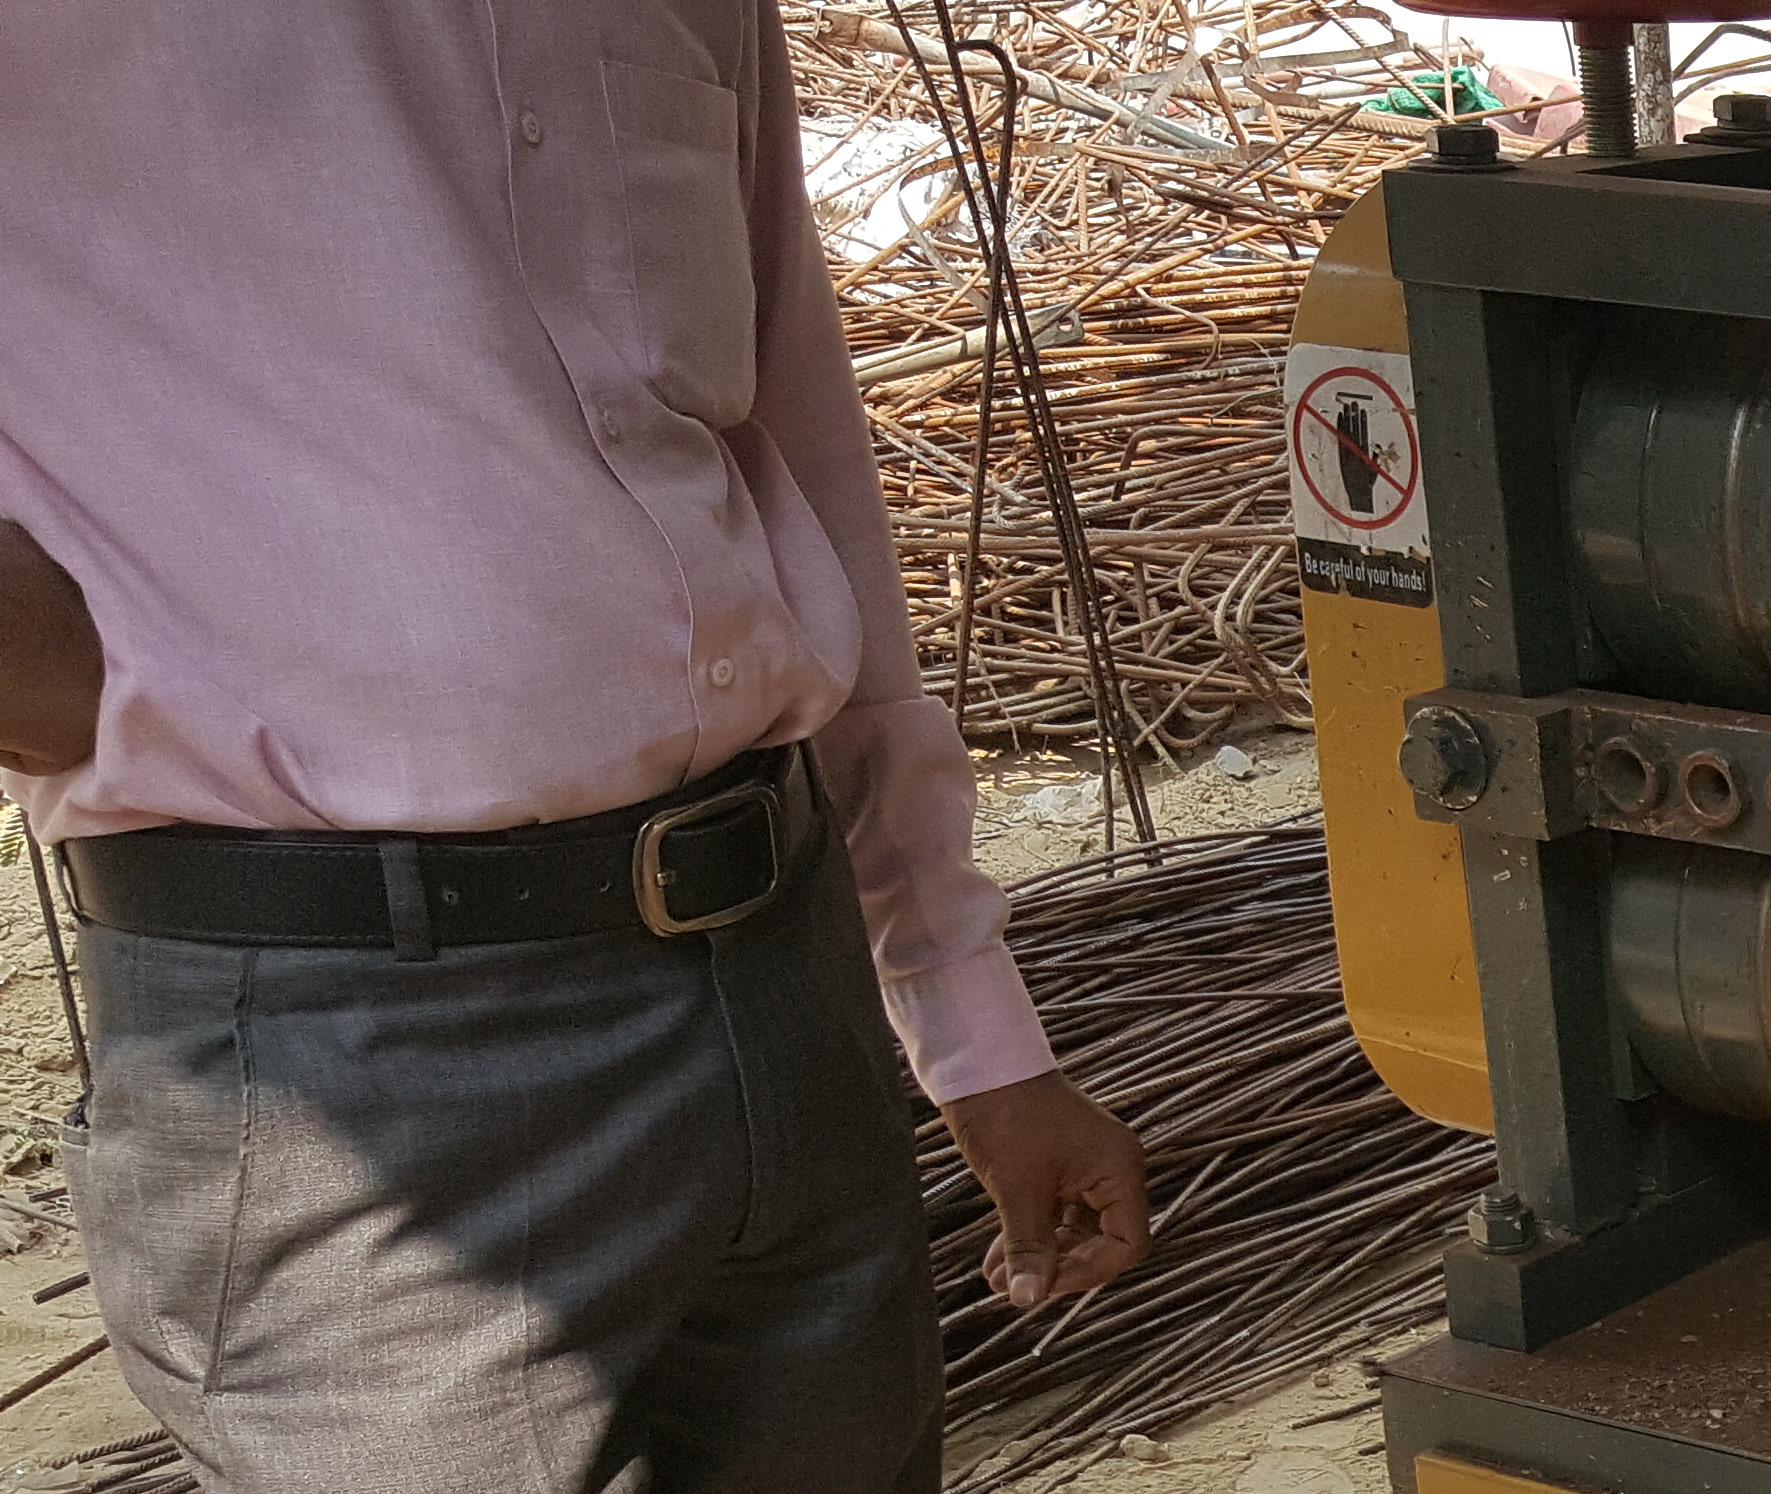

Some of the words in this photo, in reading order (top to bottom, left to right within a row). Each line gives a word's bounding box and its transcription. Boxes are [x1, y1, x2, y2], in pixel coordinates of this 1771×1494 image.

[1304, 552, 1318, 575] Be
[1319, 557, 1354, 580] careful
[1355, 560, 1366, 582] of
[1366, 565, 1390, 590] your
[1391, 565, 1427, 593] hands!
